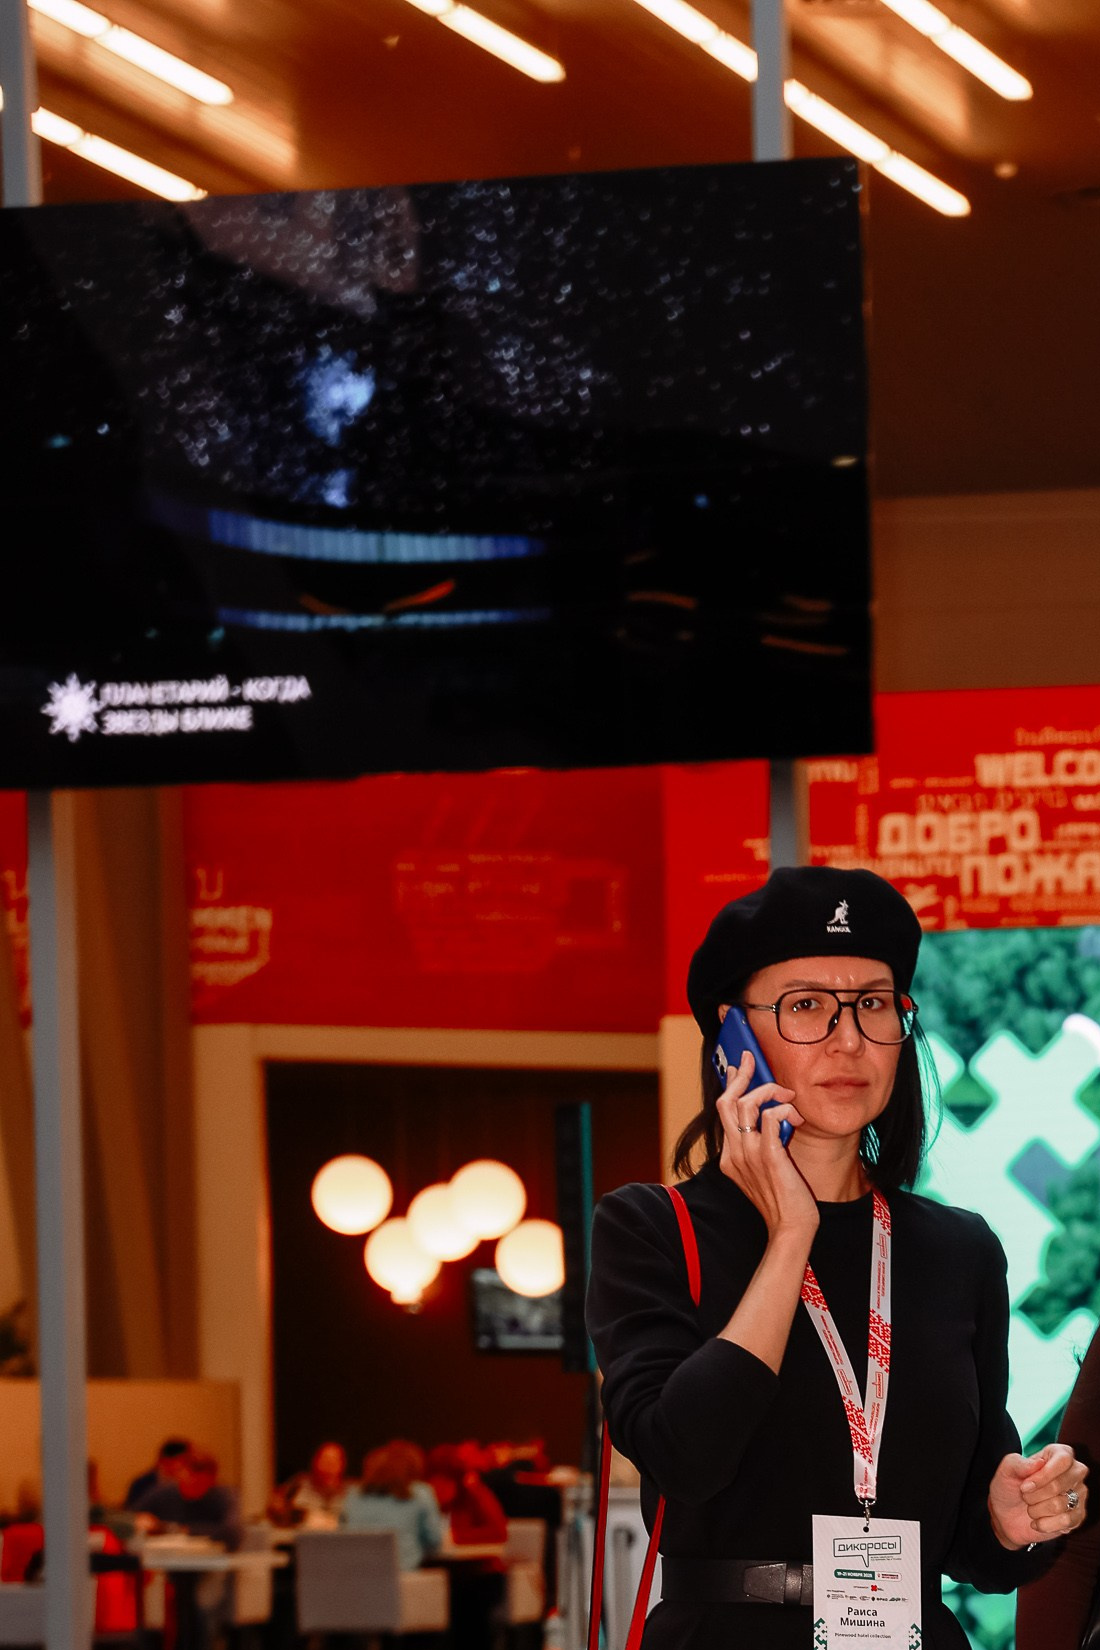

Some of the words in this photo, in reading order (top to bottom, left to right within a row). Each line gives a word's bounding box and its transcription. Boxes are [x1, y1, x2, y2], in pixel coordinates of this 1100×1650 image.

[243, 675, 311, 703] КОГДА
[101, 707, 179, 736] ЗВЕЗДЫ
[179, 703, 252, 731] БЛИЖЕ
[877, 809, 1042, 856] ДОБРО
[838, 1541, 897, 1552] ДИКОРОСЫ
[847, 1606, 878, 1616] Раиса
[840, 1617, 886, 1628] Мишина
